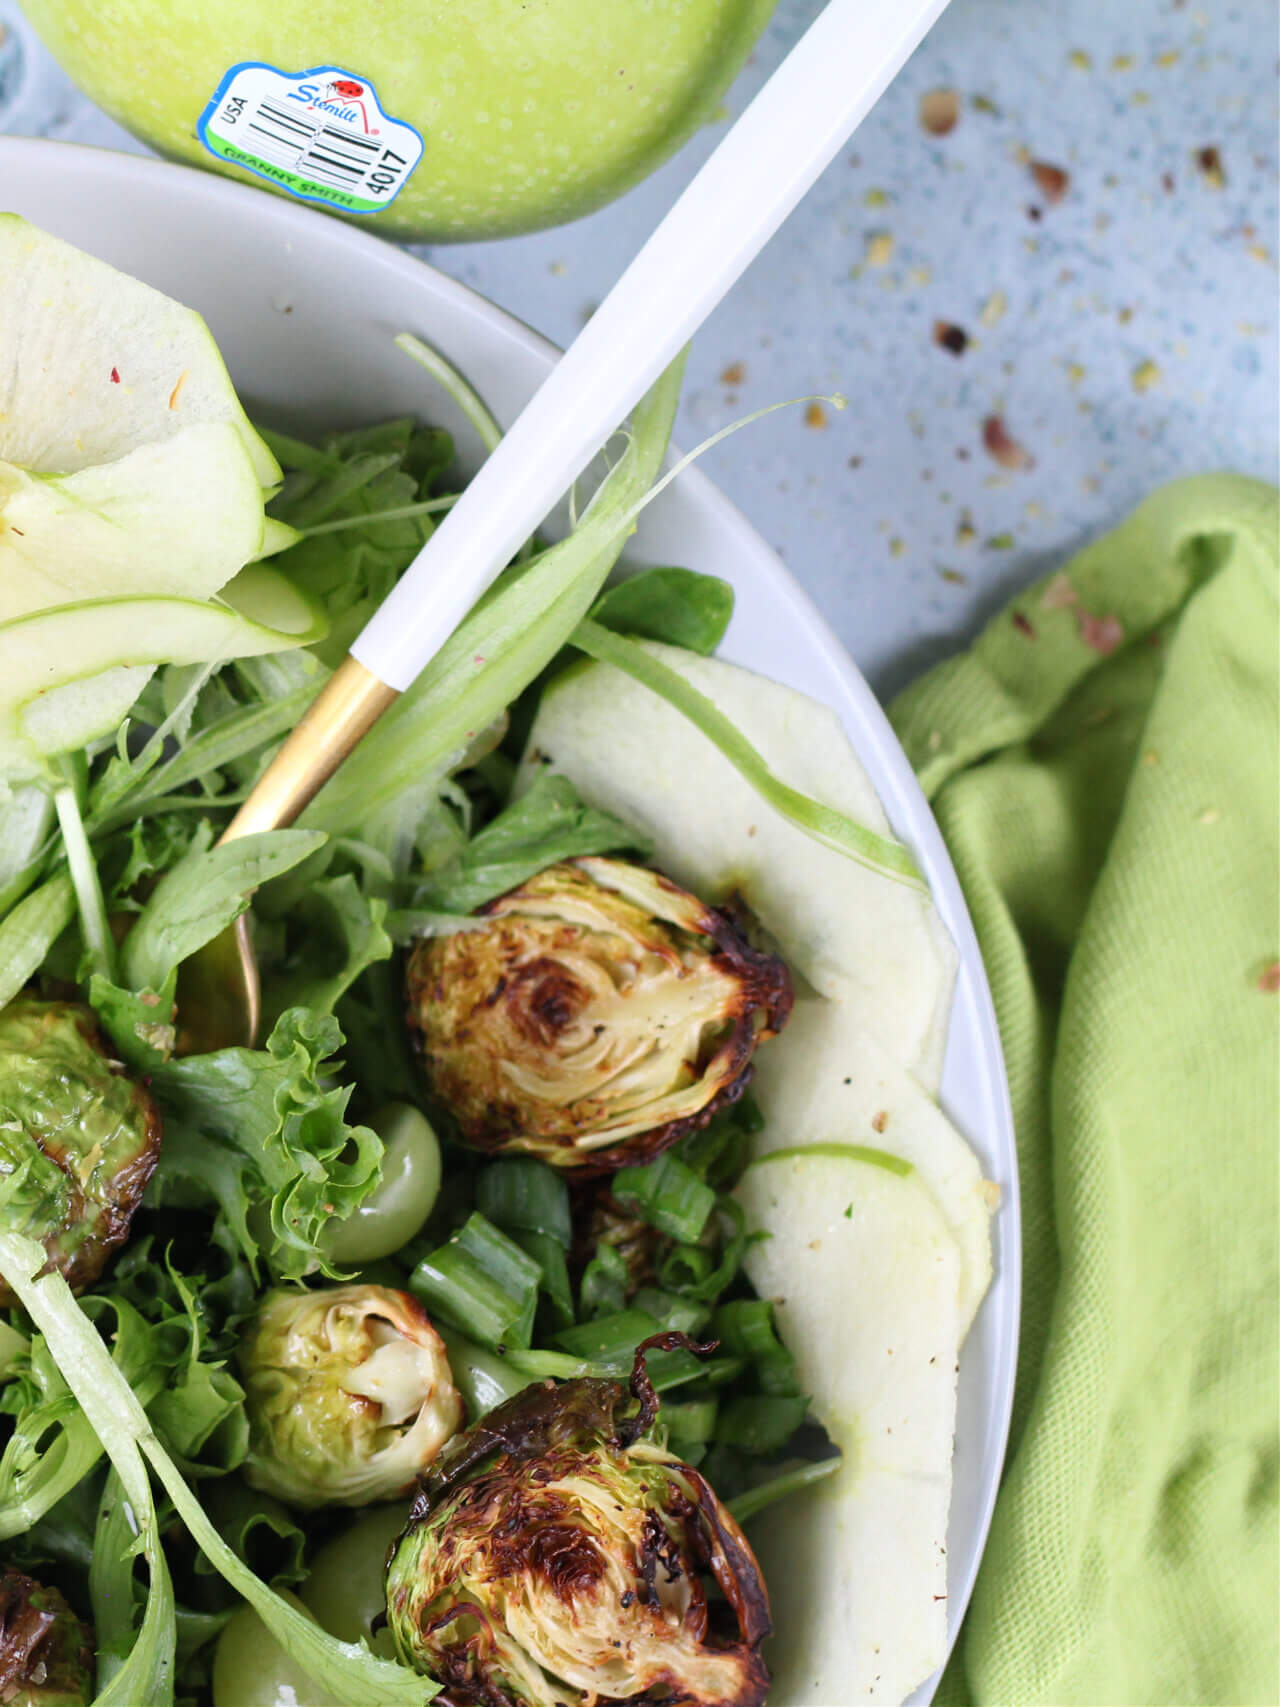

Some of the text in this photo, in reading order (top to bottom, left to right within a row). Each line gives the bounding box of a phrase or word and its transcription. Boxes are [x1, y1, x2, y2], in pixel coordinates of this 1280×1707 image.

[221, 96, 248, 124] USA
[287, 84, 360, 123] Stemilt
[224, 147, 353, 205] GRANNY SMITH
[366, 149, 407, 194] 4017
